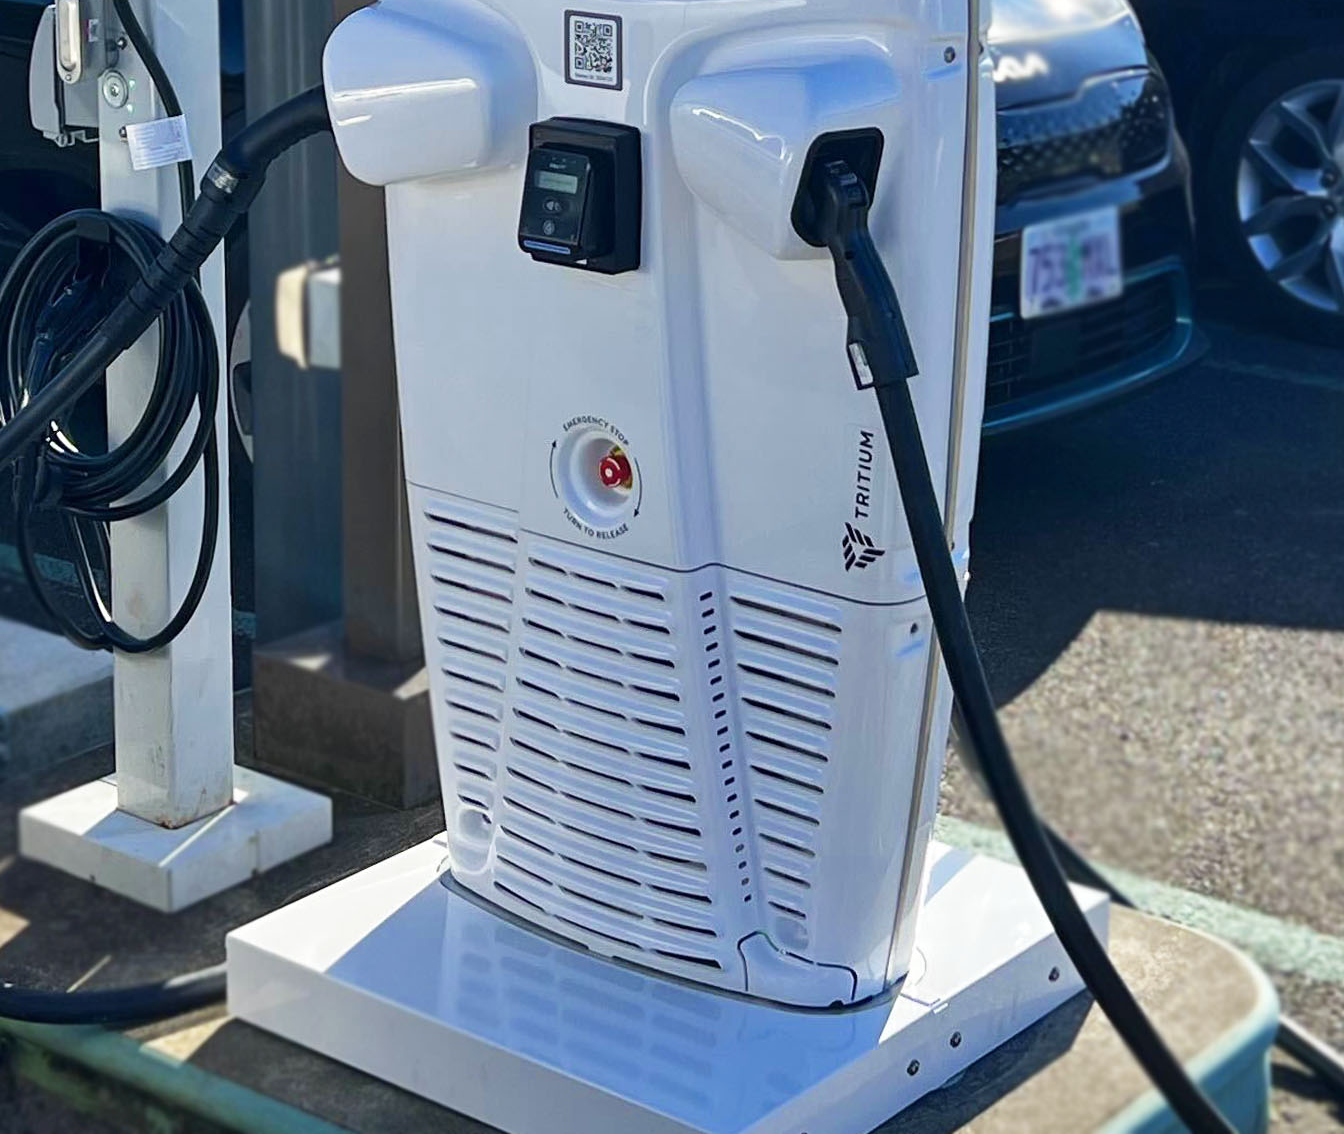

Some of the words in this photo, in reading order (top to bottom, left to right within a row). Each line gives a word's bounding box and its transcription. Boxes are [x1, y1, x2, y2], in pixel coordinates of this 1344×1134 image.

[562, 415, 609, 432] EMERGENCY
[610, 425, 630, 446] STOP
[855, 430, 875, 520] TRITIUM
[563, 507, 583, 531] TURN
[583, 524, 595, 537] TO
[596, 522, 629, 540] RELEASE
